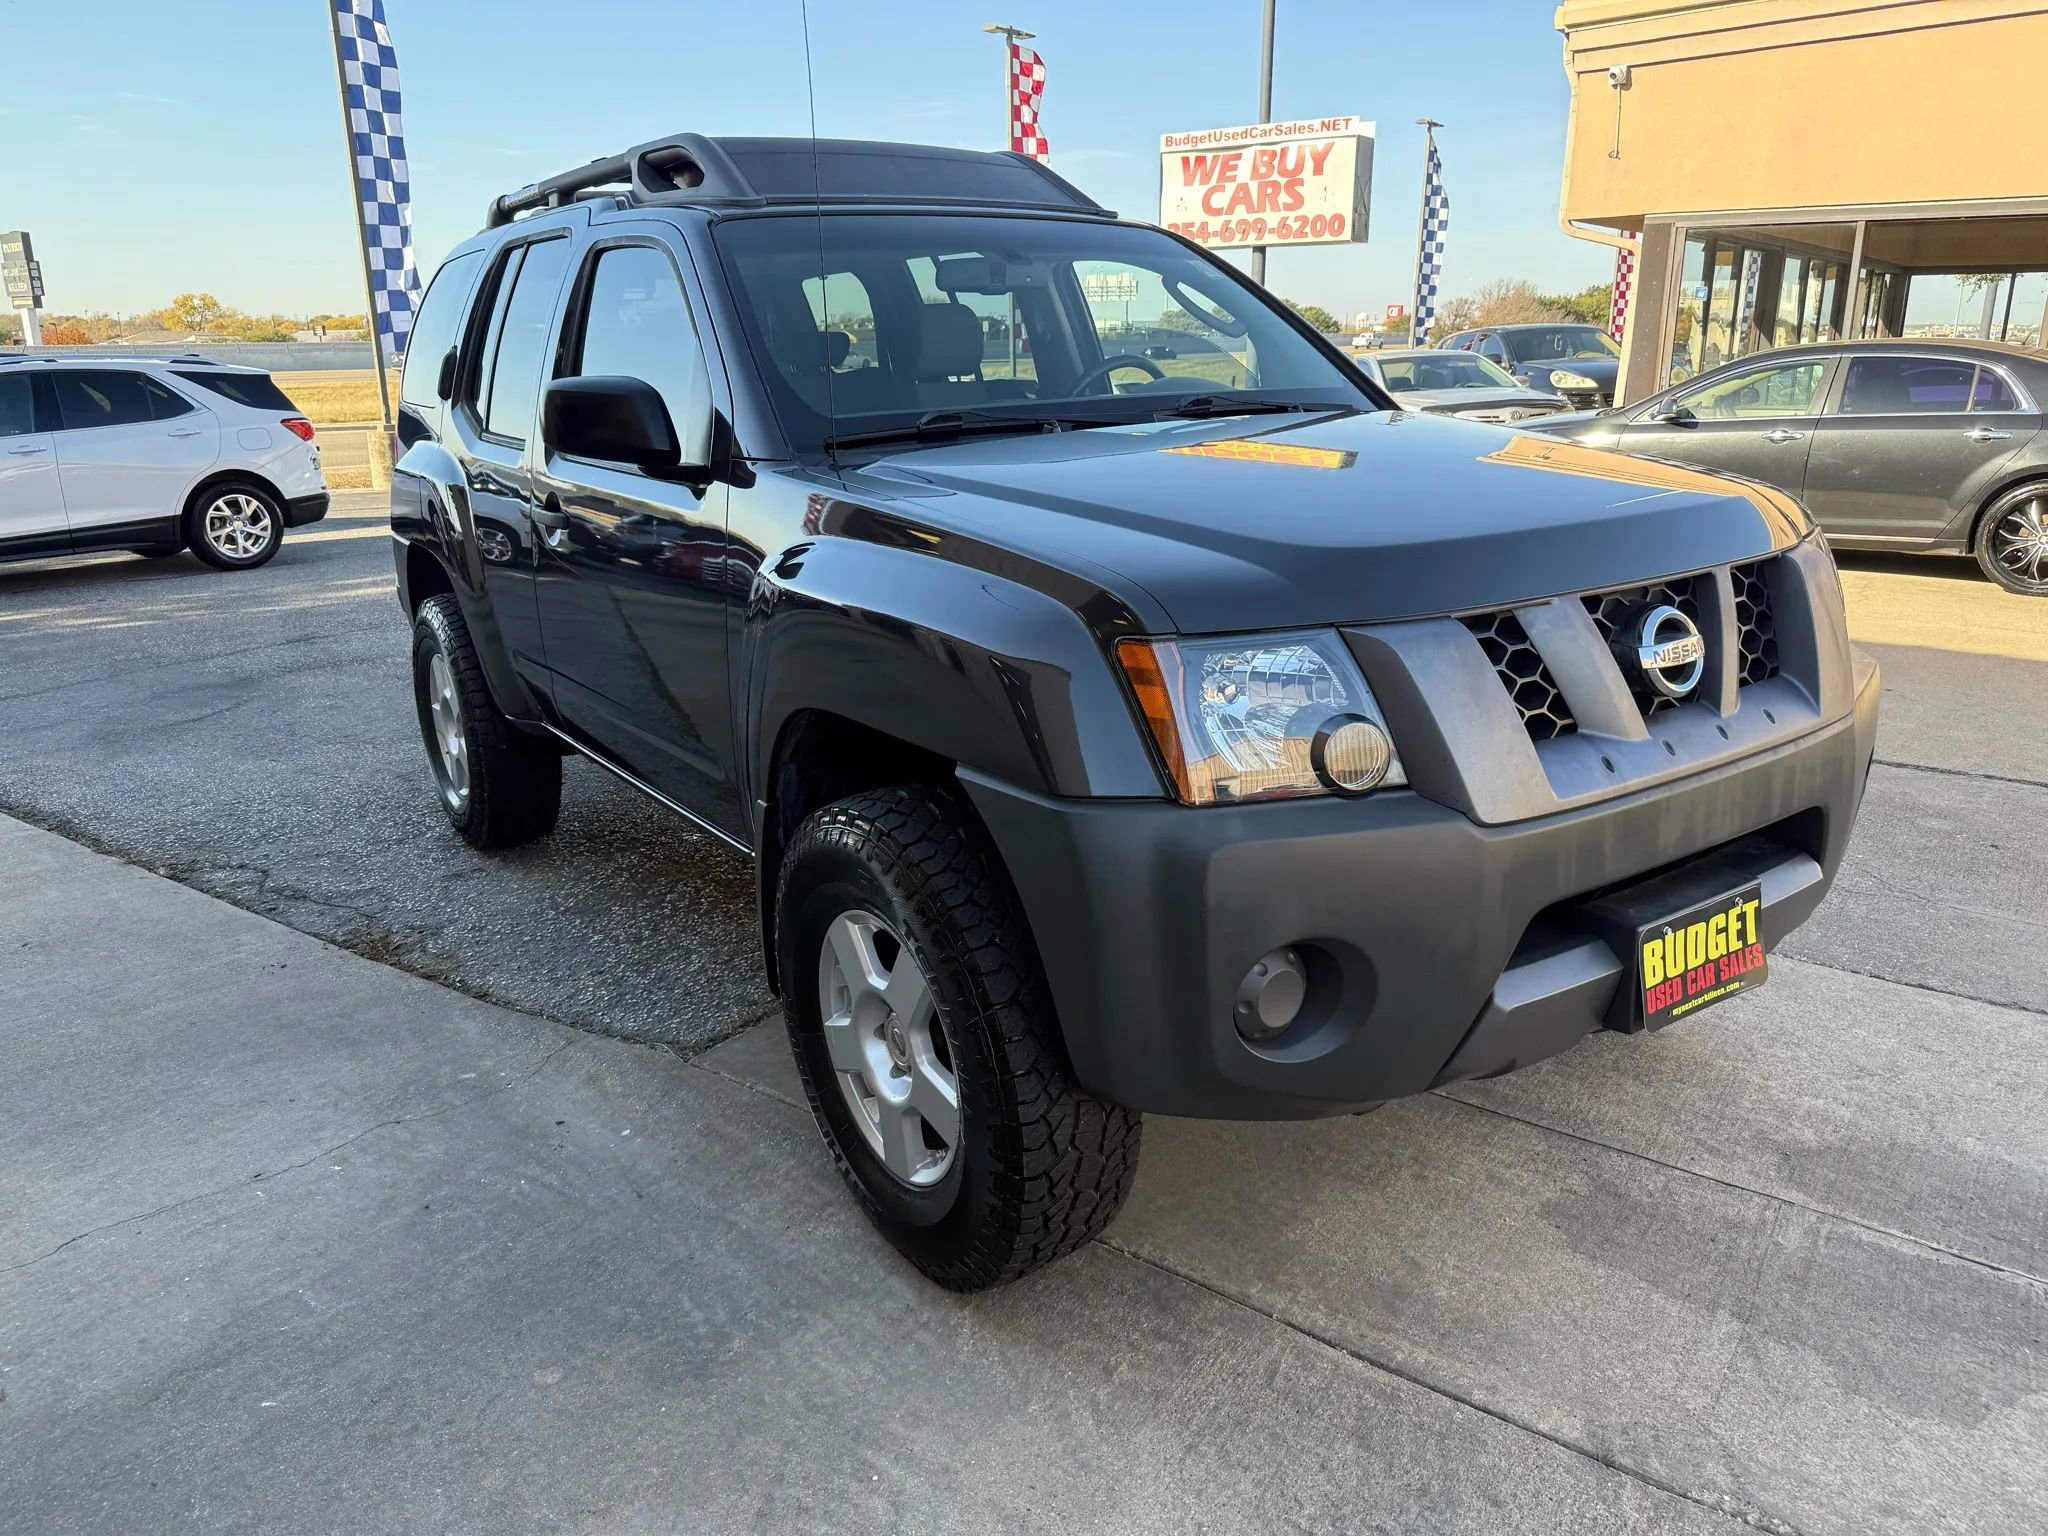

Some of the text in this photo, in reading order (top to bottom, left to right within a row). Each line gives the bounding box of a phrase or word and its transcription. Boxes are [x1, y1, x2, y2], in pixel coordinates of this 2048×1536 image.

[1165, 118, 1352, 147] BudgetUsedCarSales.NET
[1181, 142, 1335, 186] WE BUY
[1201, 178, 1304, 217] CARS
[1653, 638, 1705, 664] NISSAN
[1643, 899, 1759, 989] BUDGET
[1646, 943, 1764, 1014] USED CAR SALES
[1672, 981, 1740, 1015] mynextcarkilleen.com
